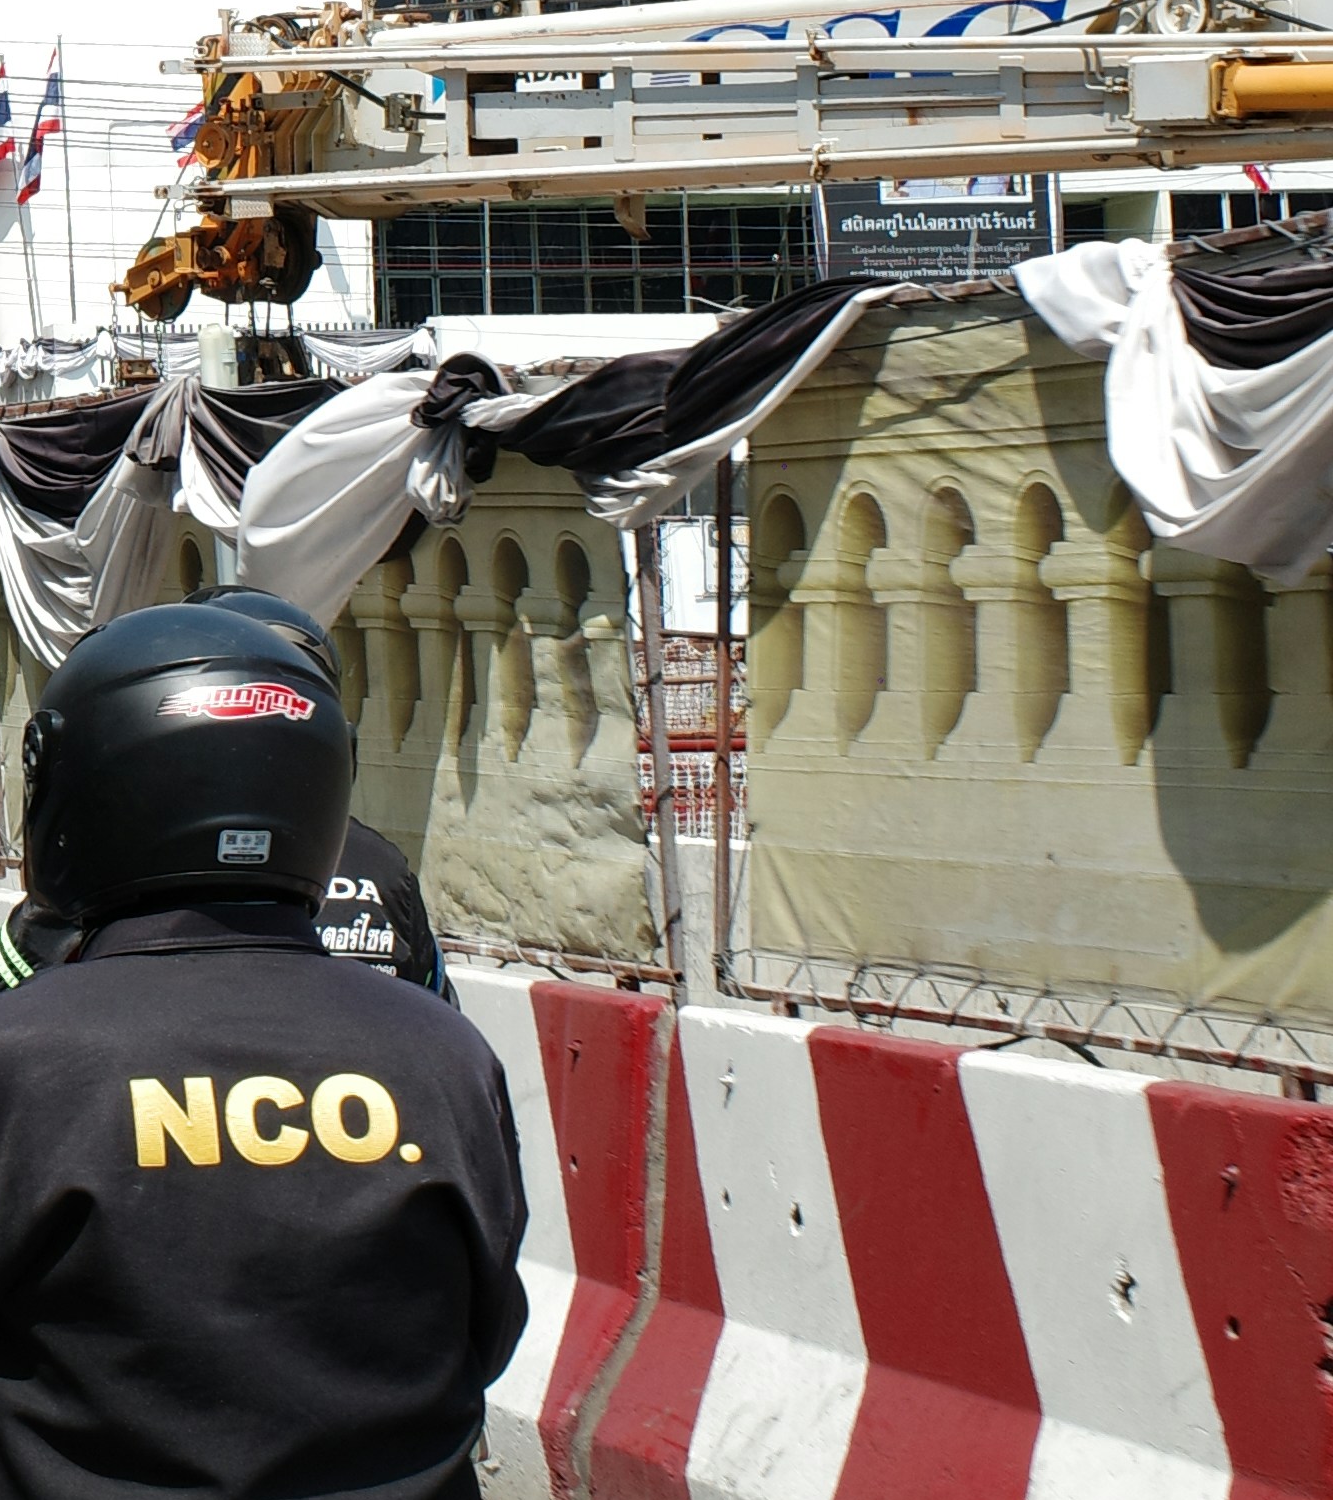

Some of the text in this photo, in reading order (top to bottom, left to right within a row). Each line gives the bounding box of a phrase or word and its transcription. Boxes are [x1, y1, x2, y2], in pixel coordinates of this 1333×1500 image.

[325, 876, 384, 906] DA
[315, 912, 395, 952] ตอร์ไซค์
[130, 1072, 423, 1168] NCO.
